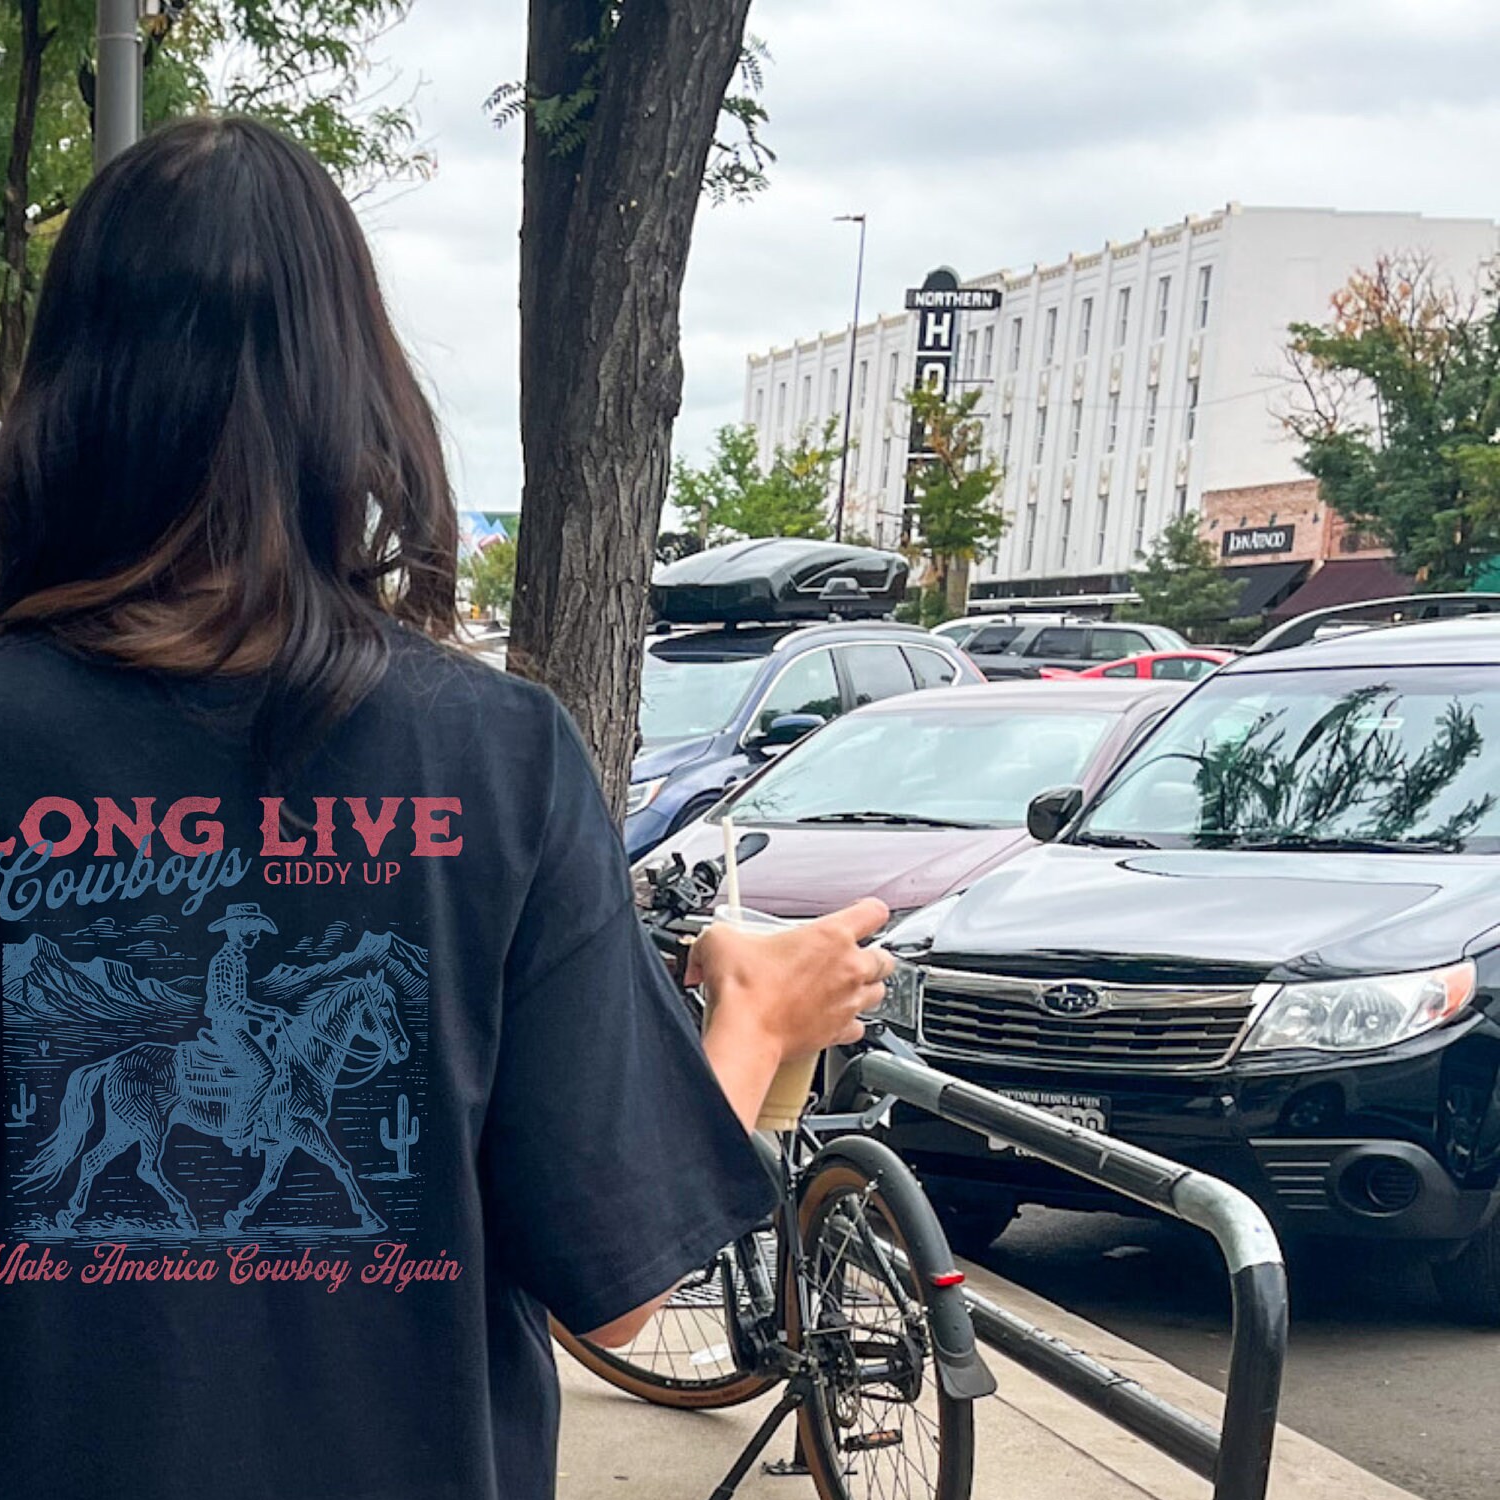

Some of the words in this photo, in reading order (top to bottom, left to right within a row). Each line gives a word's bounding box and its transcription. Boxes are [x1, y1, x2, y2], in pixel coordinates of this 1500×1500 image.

[915, 291, 994, 308] NORTHERN
[259, 796, 463, 857] LIVE
[263, 862, 352, 885] GIDDY
[363, 862, 400, 884] UP
[80, 1242, 218, 1286] America
[226, 1242, 352, 1293] Cowboy
[360, 1242, 463, 1293] Again
